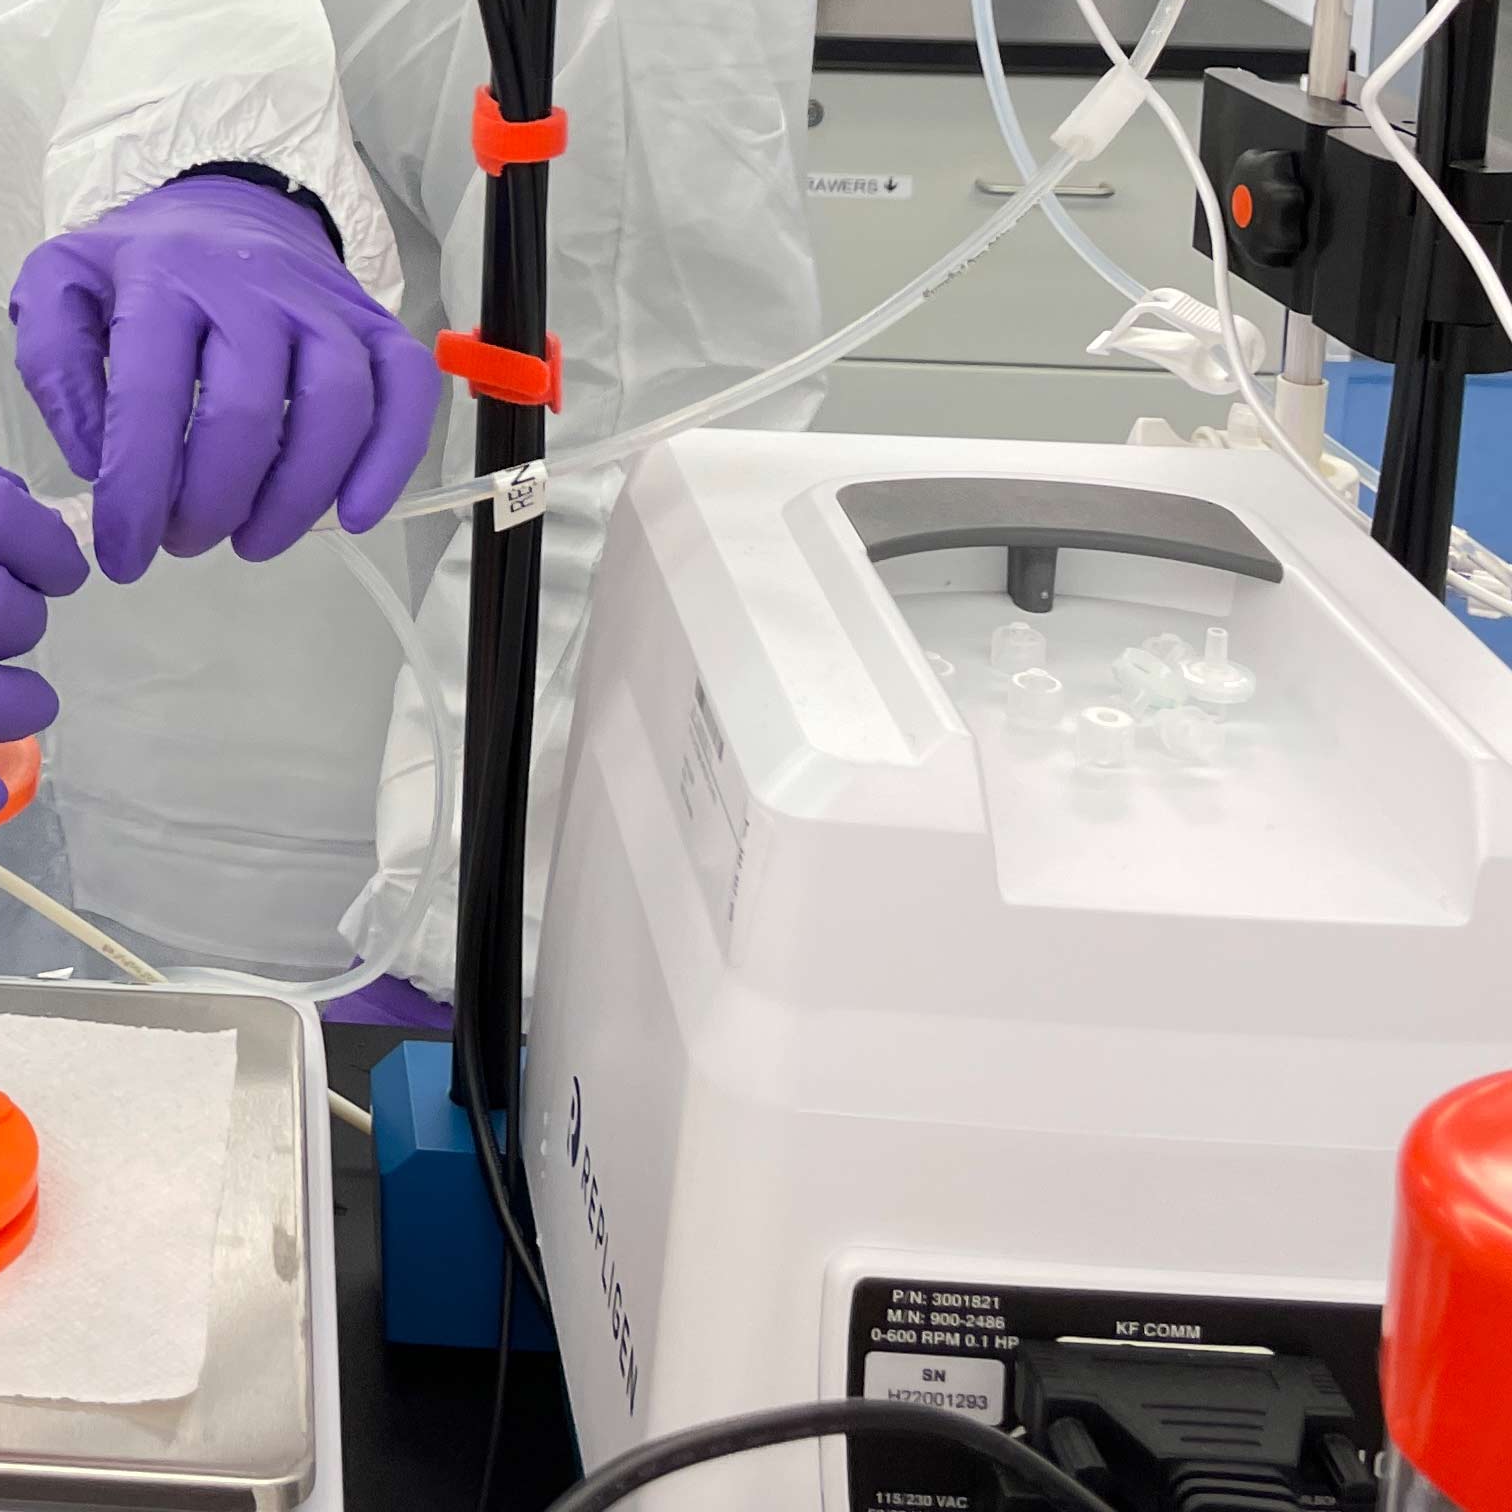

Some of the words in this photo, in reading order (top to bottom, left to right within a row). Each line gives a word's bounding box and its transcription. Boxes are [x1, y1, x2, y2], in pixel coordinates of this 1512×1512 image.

[581, 1145, 639, 1418] REPLIGEN
[892, 1289, 927, 1305] P/N:
[931, 1292, 1001, 1310] 3001821
[887, 1308, 925, 1325] M/N:
[929, 1311, 1006, 1330] 900-2486
[1115, 1320, 1140, 1335] KF
[1143, 1322, 1201, 1339] COMM
[870, 1327, 917, 1344] 0-600
[921, 1330, 961, 1347] RPM
[964, 1333, 988, 1348] 0.1
[994, 1335, 1020, 1350] HP
[936, 1495, 968, 1509] VAC
